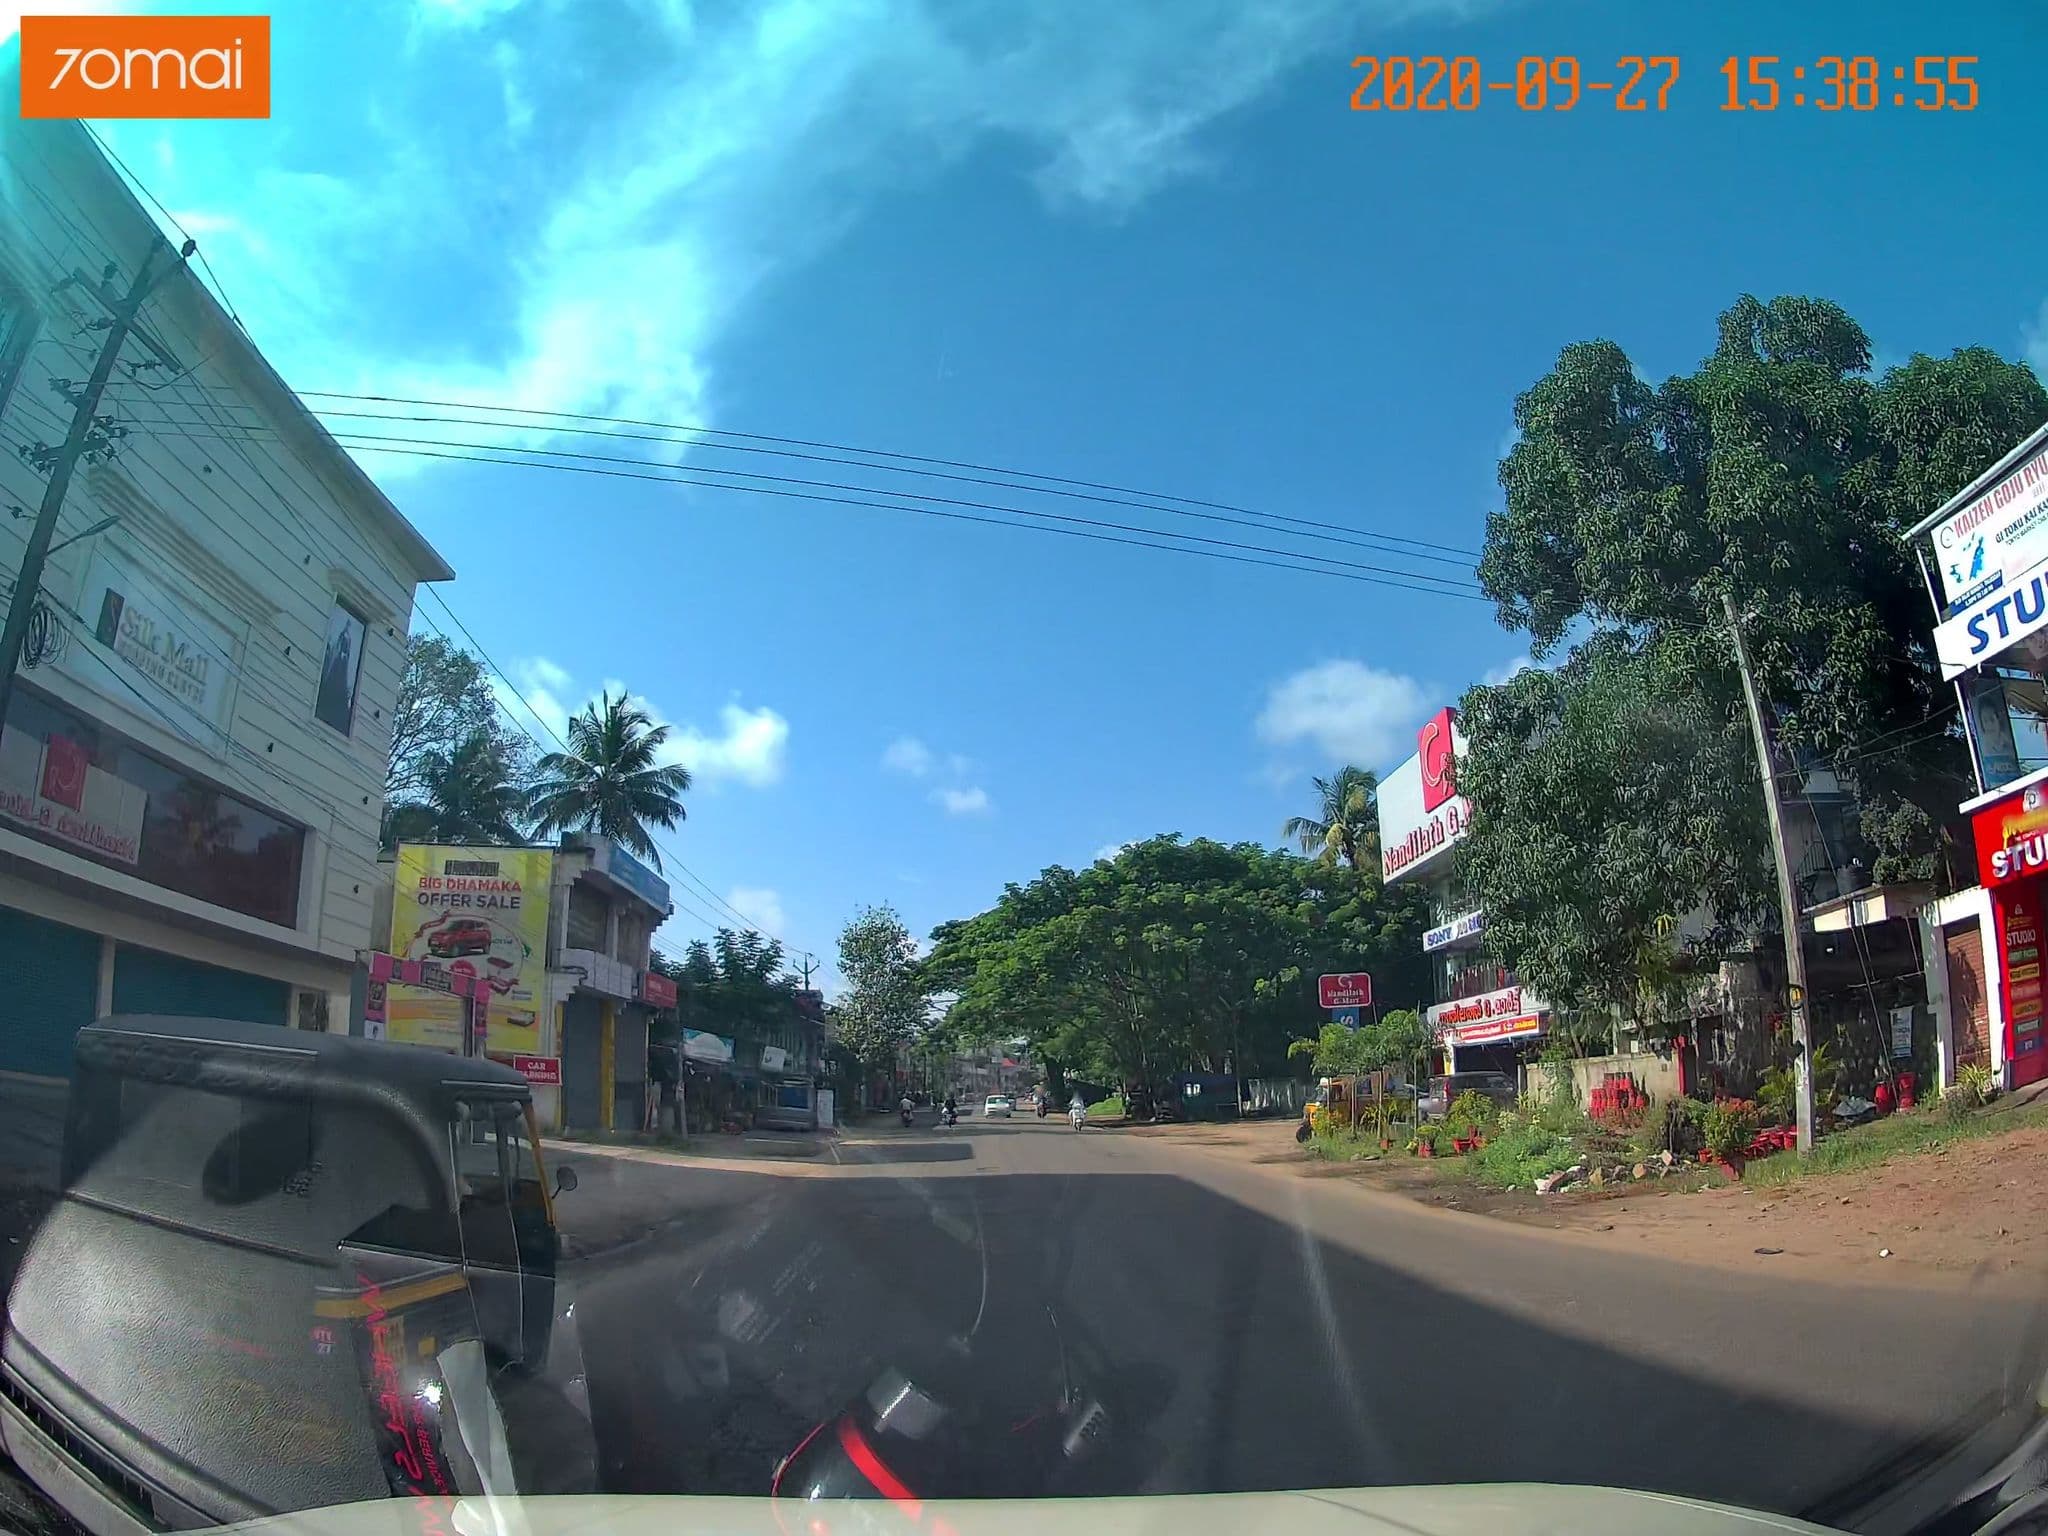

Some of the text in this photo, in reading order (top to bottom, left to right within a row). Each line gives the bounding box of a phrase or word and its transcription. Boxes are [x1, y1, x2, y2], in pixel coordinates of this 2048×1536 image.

[1953, 497, 1995, 539] KAIZEN
[1994, 473, 2025, 510] GOJU
[1967, 571, 2048, 655] STU
[1383, 813, 1446, 877] Nandilath
[418, 876, 522, 892] BIG DHAMAKA
[417, 893, 521, 910] OFFER SALE
[1426, 926, 1453, 946] SONY
[2006, 929, 2036, 947] STUDIO
[518, 1070, 557, 1080] ARKING
[527, 1062, 546, 1071] CAR
